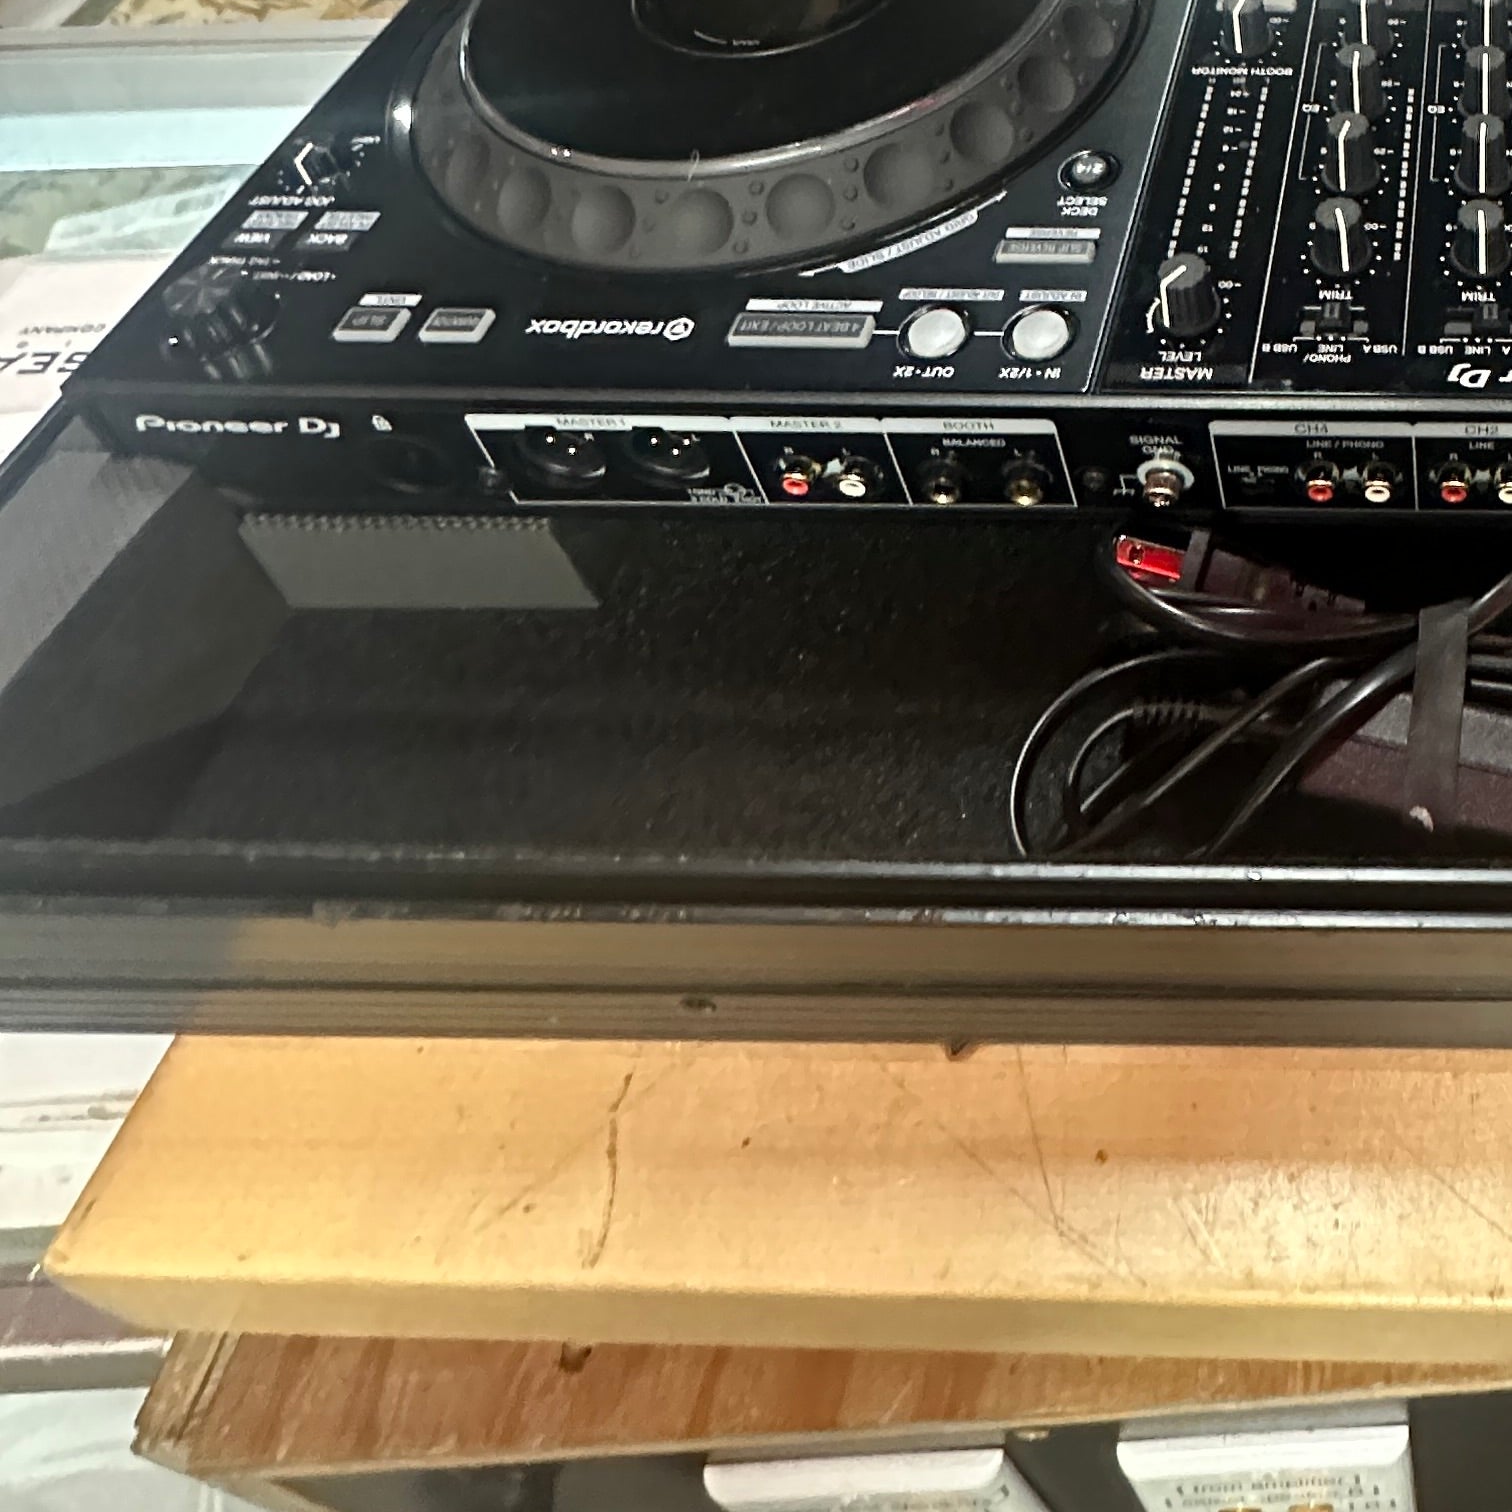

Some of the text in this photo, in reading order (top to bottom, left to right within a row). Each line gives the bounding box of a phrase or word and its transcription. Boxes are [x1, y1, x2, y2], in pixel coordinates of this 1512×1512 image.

[1192, 66, 1293, 76] BOOTH MONITOR
[248, 196, 304, 205] ADJUST
[1057, 196, 1108, 207] SELECT
[1061, 206, 1099, 216] DECK
[234, 233, 270, 243] VIEW
[307, 233, 348, 243] BACK
[1319, 288, 1353, 300] TRIM
[1462, 290, 1496, 302] TRIM
[19, 324, 106, 334] COMPANY
[524, 317, 665, 339] rekordbox
[819, 320, 850, 331] BEAT
[1274, 342, 1298, 354] USB
[1317, 342, 1344, 353] LINE
[1363, 343, 1397, 354] USB A
[1464, 345, 1491, 355] LINE
[1502, 345, 1511, 355] A
[1157, 350, 1202, 362] LEVEL
[923, 366, 954, 377] OUT
[1044, 367, 1061, 378] IN
[1140, 366, 1213, 380] MASTER
[135, 413, 288, 434] Pioneer
[556, 417, 615, 427] MASTER
[770, 420, 828, 430] MASTER
[942, 421, 994, 431] BOOTH
[1295, 424, 1329, 434] CH4
[1465, 425, 1499, 434] CH2
[942, 438, 1006, 448] BALANCED
[1129, 436, 1182, 446] SIGNAL
[1469, 442, 1495, 450] LINE
